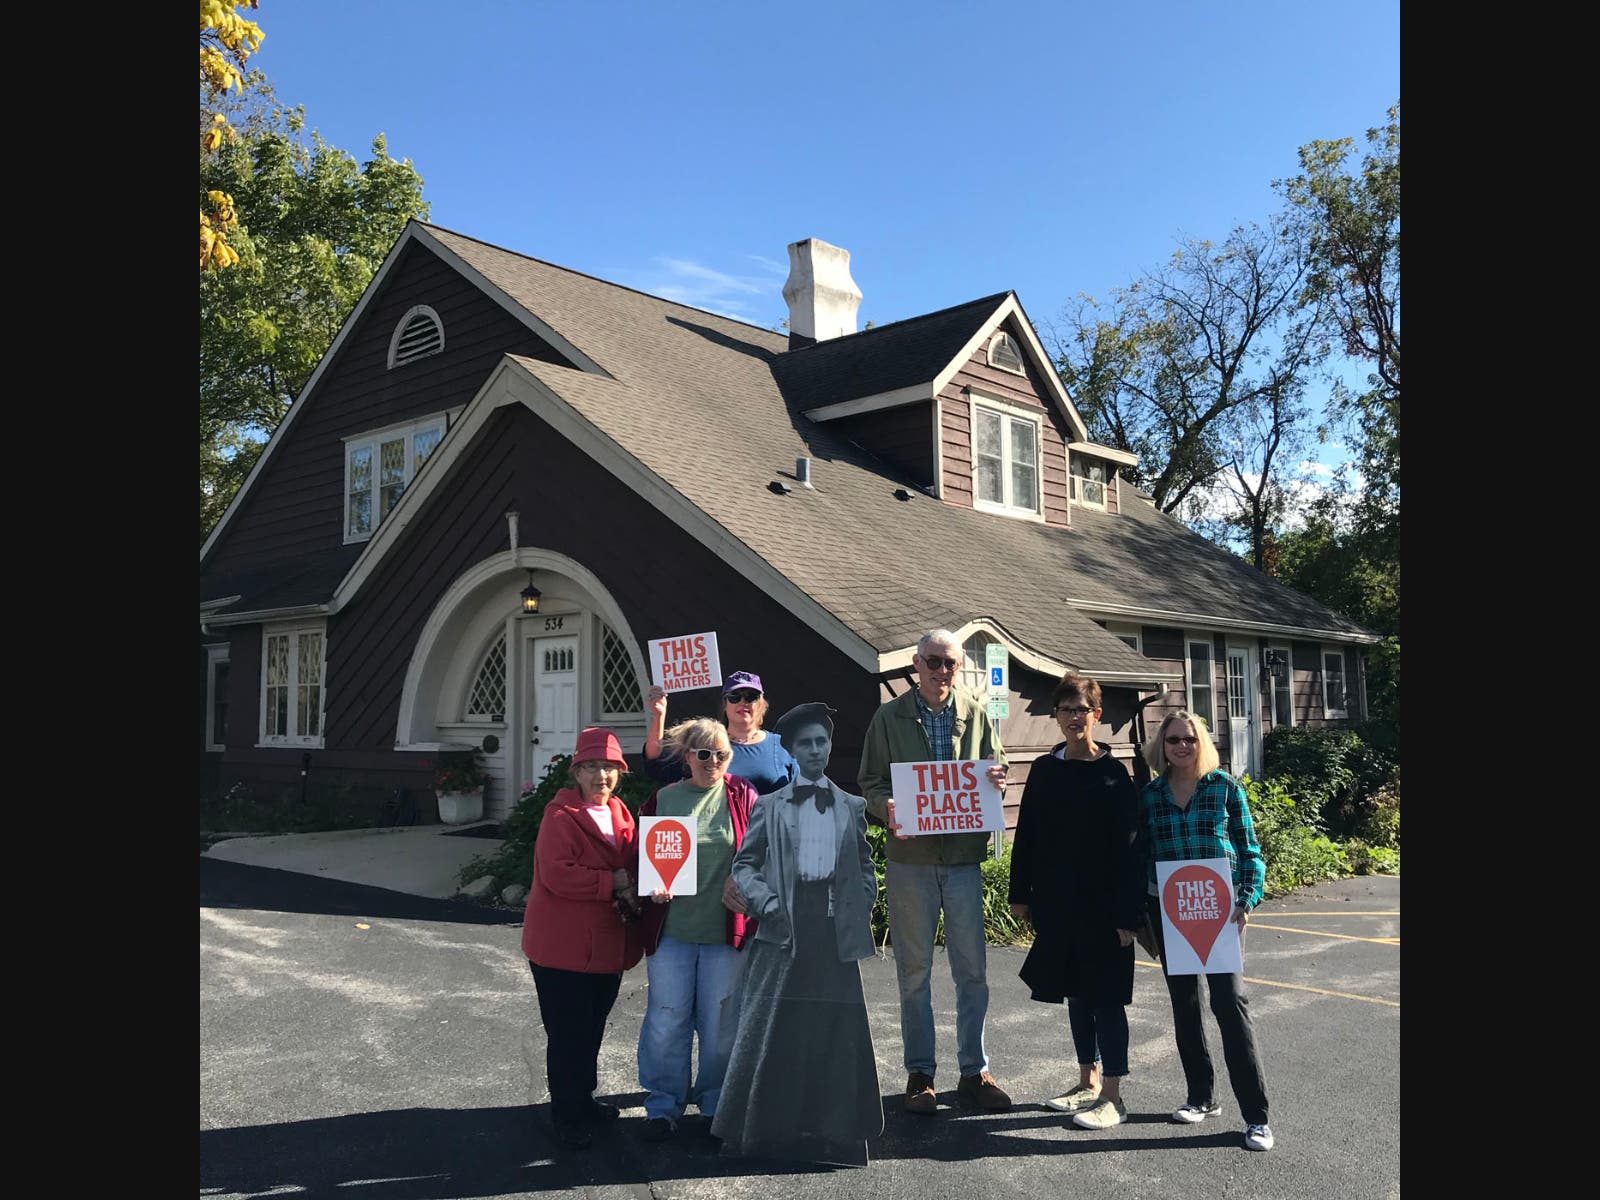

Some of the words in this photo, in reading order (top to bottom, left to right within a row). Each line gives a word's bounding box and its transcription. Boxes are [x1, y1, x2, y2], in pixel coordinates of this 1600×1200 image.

[544, 617, 564, 631] 534
[659, 636, 706, 662] THIS
[662, 658, 709, 678] PLACE
[664, 674, 711, 690] MATTERS
[912, 762, 977, 792] THIS
[916, 792, 982, 815] PLACE
[917, 814, 984, 831] MATTERS
[655, 830, 682, 843] THIS
[655, 843, 682, 852] PLACE
[1175, 880, 1216, 898] THIS
[1178, 898, 1218, 911] PLACE
